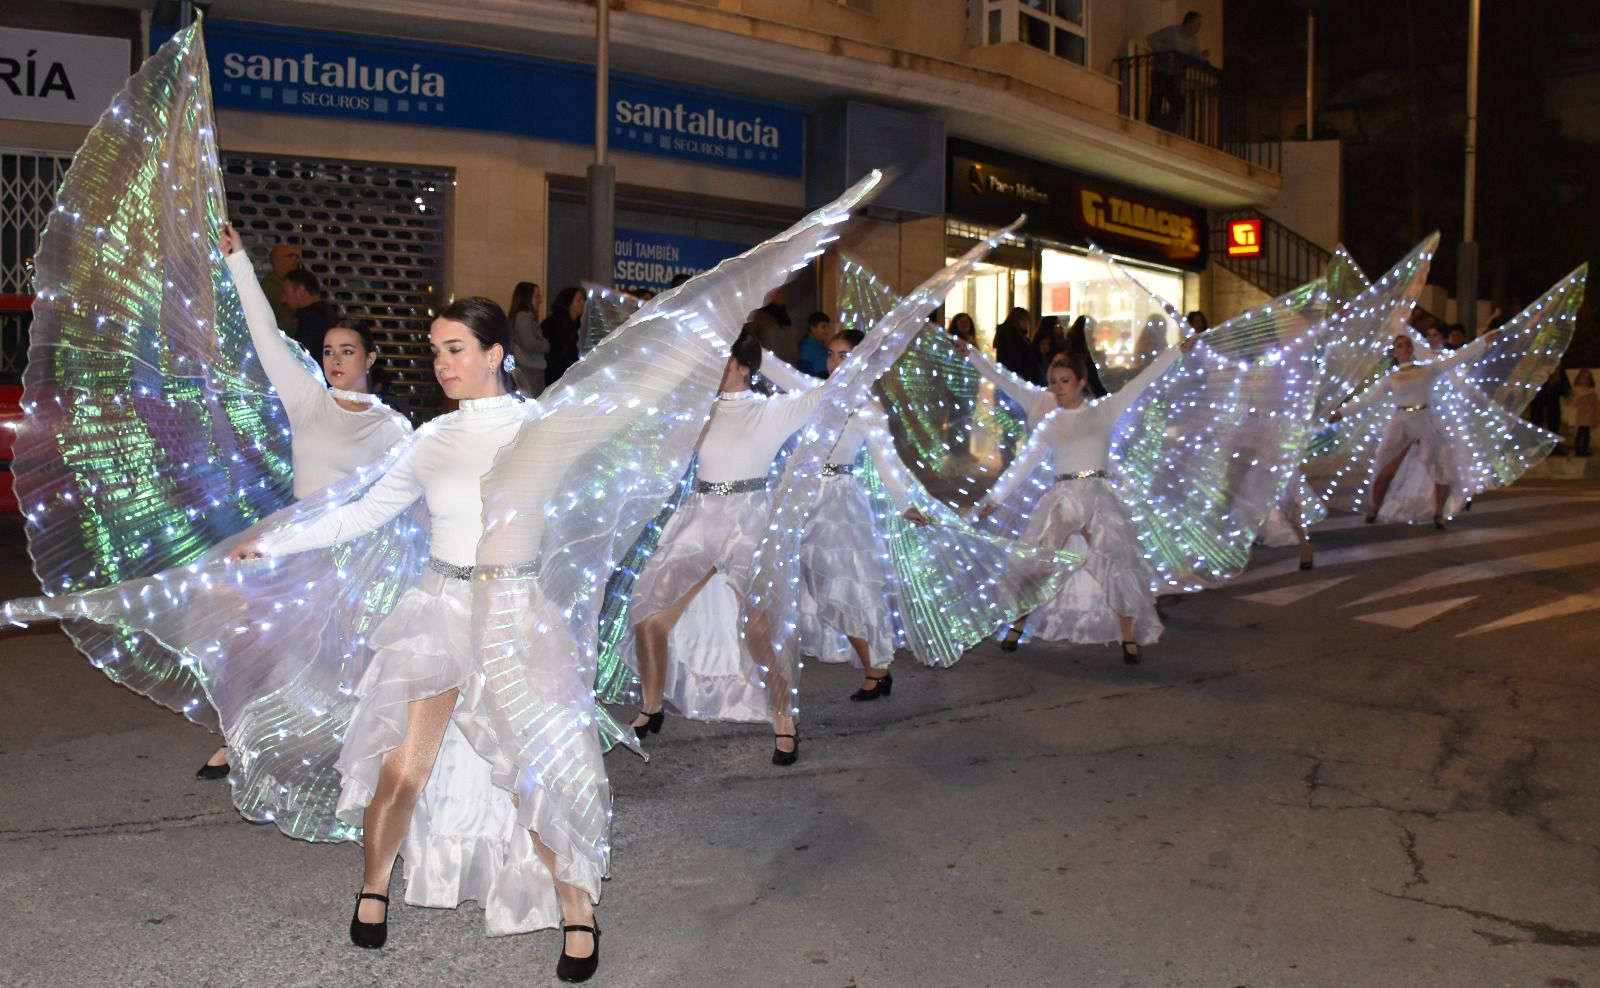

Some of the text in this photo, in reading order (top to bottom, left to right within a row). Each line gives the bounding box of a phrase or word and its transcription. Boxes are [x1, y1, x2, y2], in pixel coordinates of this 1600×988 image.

[223, 52, 445, 97] santalucía
[302, 91, 369, 110] SEGUROS
[615, 100, 779, 148] santalucía
[674, 138, 725, 157] SEGUROS
[1108, 197, 1193, 240] TABACOS
[614, 239, 680, 261] QUÍ TAMBIÉN
[614, 260, 706, 284] SEGURA
